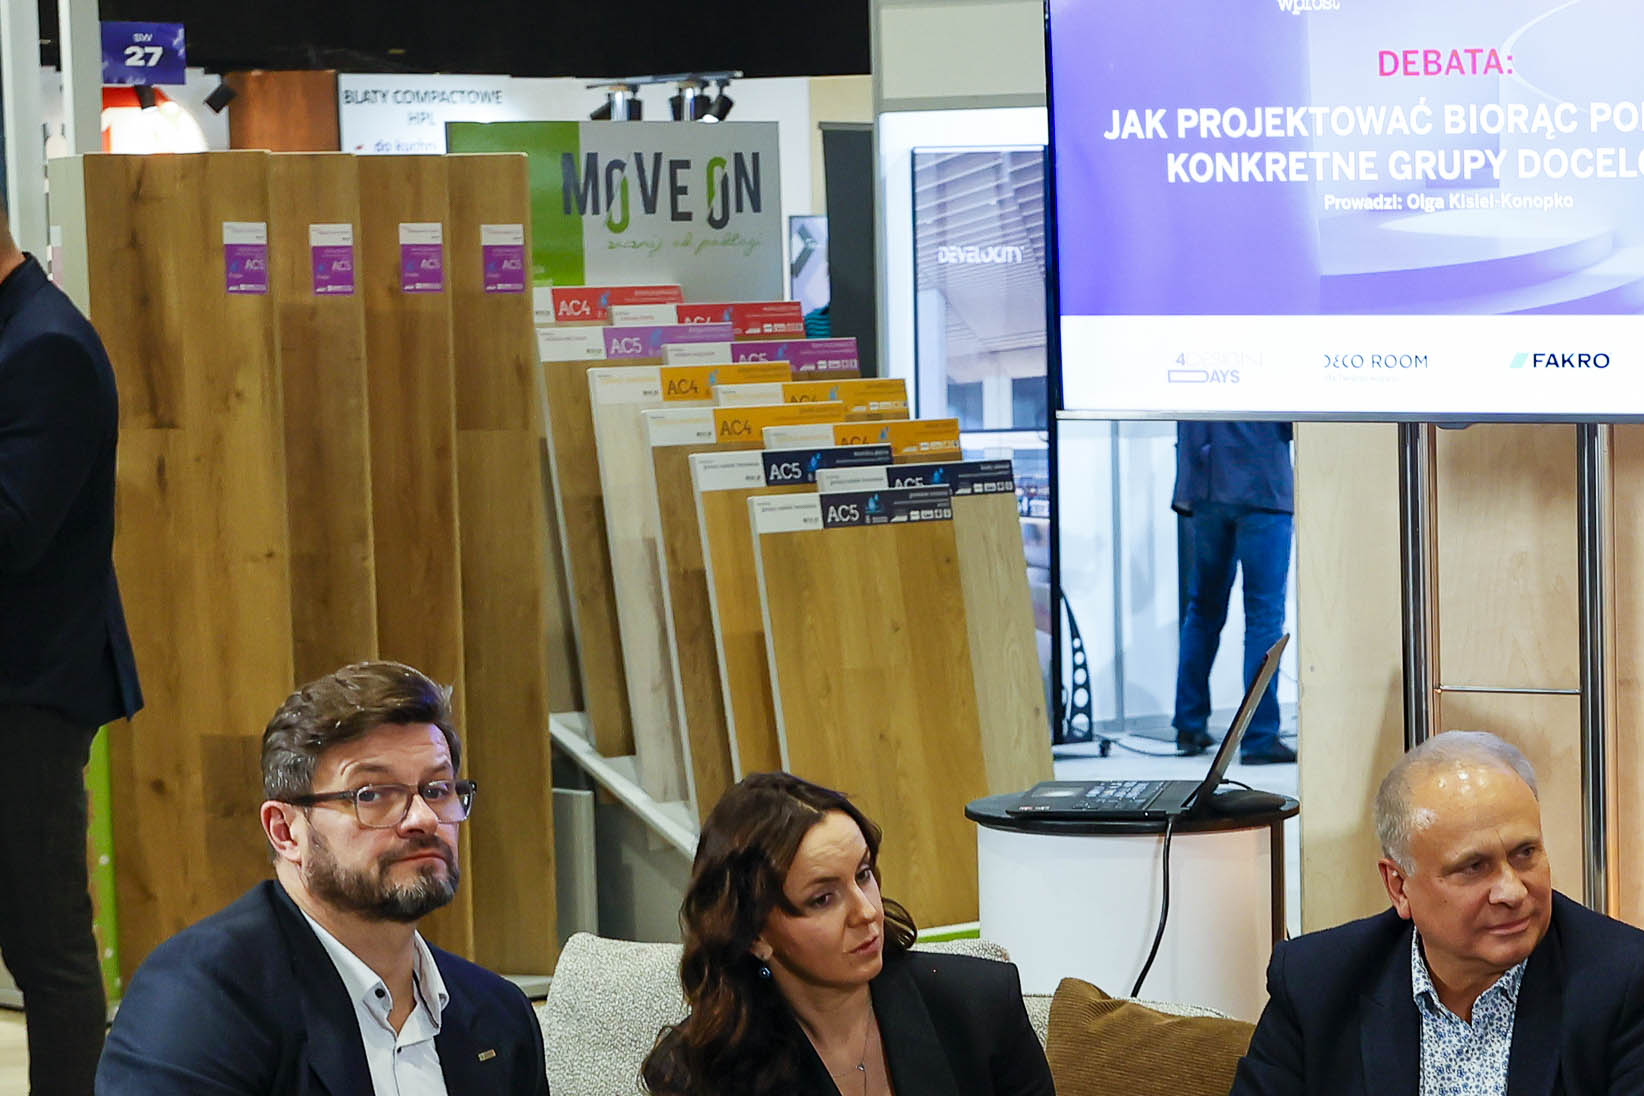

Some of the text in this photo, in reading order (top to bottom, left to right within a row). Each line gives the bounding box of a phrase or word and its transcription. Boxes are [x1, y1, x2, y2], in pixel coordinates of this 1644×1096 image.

[124, 45, 163, 67] 27
[1379, 48, 1513, 76] DEBATA:
[344, 89, 503, 104] BLATY COMPACTOWE
[1104, 108, 1168, 140] JAK
[1178, 97, 1433, 138] PROJEKTOWAĆ
[1444, 102, 1578, 139] BIORĄC
[1167, 150, 1379, 183] KONKRETNE
[1388, 148, 1506, 181] GRUPY
[561, 152, 762, 233] MOVE ON
[1407, 192, 1444, 212] Olga
[558, 299, 591, 317] AC4
[610, 337, 642, 354] AC5
[1371, 354, 1429, 369] ROOM
[1533, 353, 1610, 368] FAKRO
[667, 379, 699, 395] AC4
[720, 420, 752, 436] AC4
[769, 463, 802, 480] AC5
[827, 504, 860, 523] AC5
